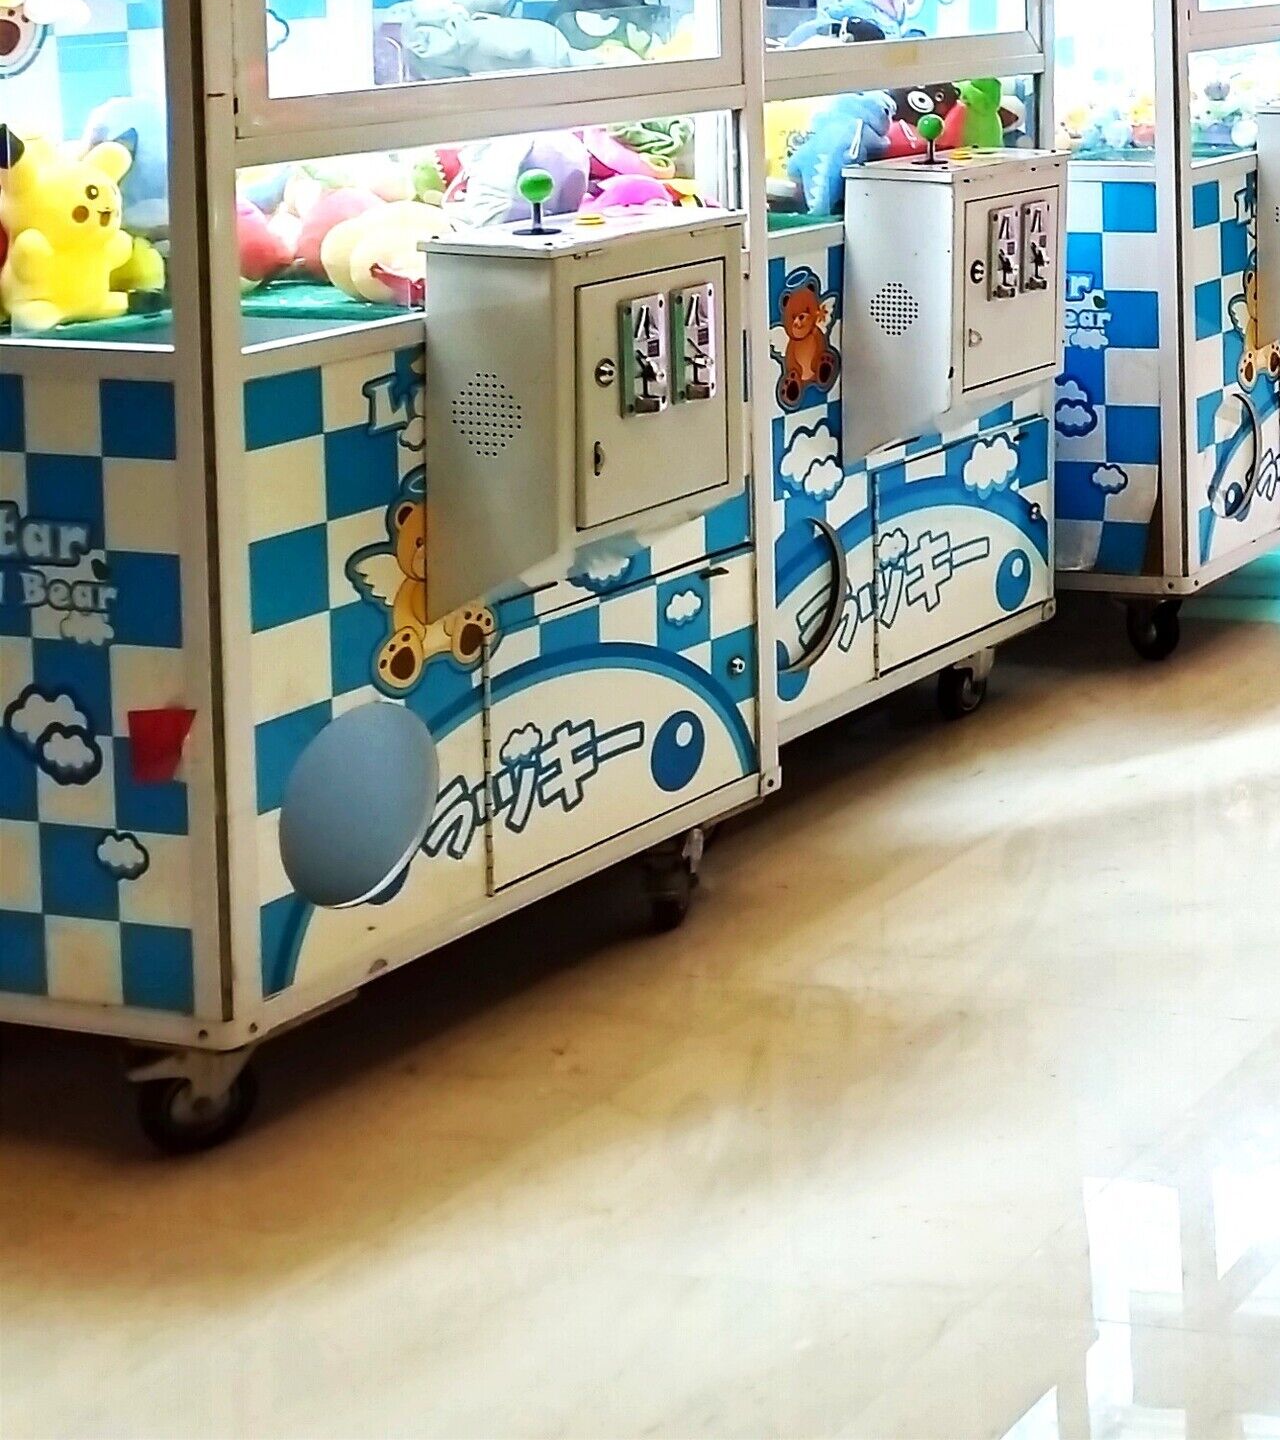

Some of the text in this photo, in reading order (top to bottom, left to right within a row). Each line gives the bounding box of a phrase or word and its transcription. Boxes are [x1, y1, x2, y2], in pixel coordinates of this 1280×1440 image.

[1064, 309, 1112, 330] ear
[0, 500, 90, 566] tar
[20, 568, 118, 613] Bear
